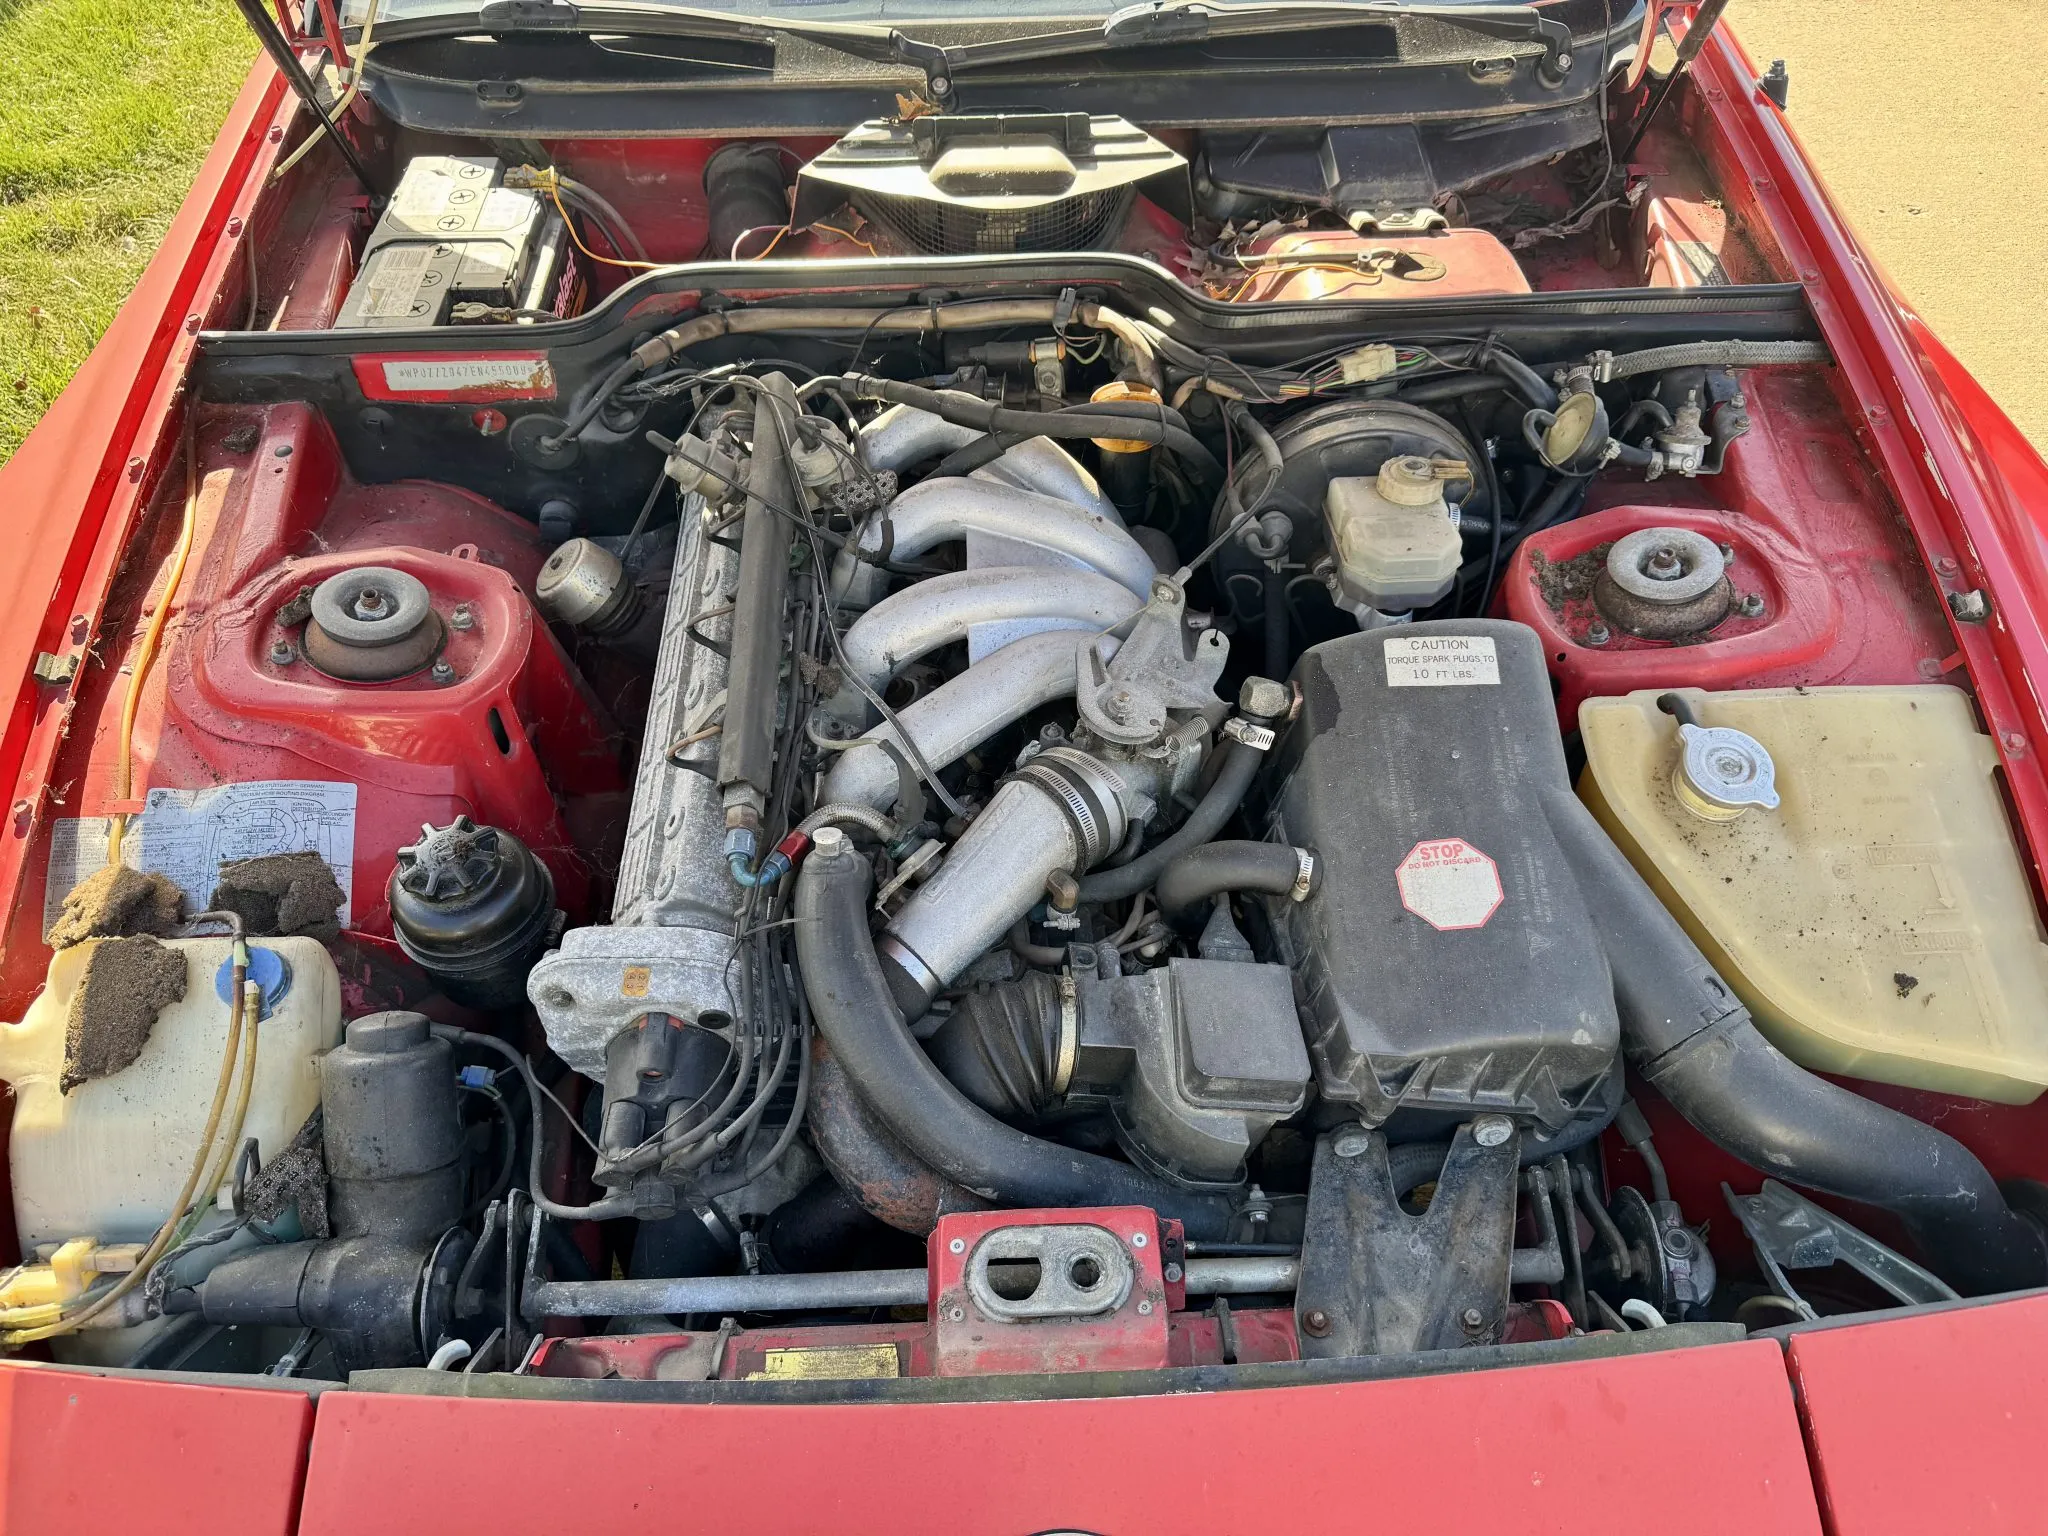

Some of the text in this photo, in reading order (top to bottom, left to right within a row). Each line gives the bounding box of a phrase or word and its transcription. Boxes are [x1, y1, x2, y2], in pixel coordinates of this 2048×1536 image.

[1410, 640, 1469, 650] CAUTION
[1387, 654, 1495, 665] TORQUE SPARK PLUGS TO
[1413, 669, 1429, 679] 10
[1436, 670, 1448, 679] FT
[1419, 843, 1464, 861] STOP
[1408, 856, 1481, 870] DO NOT DISCARD
